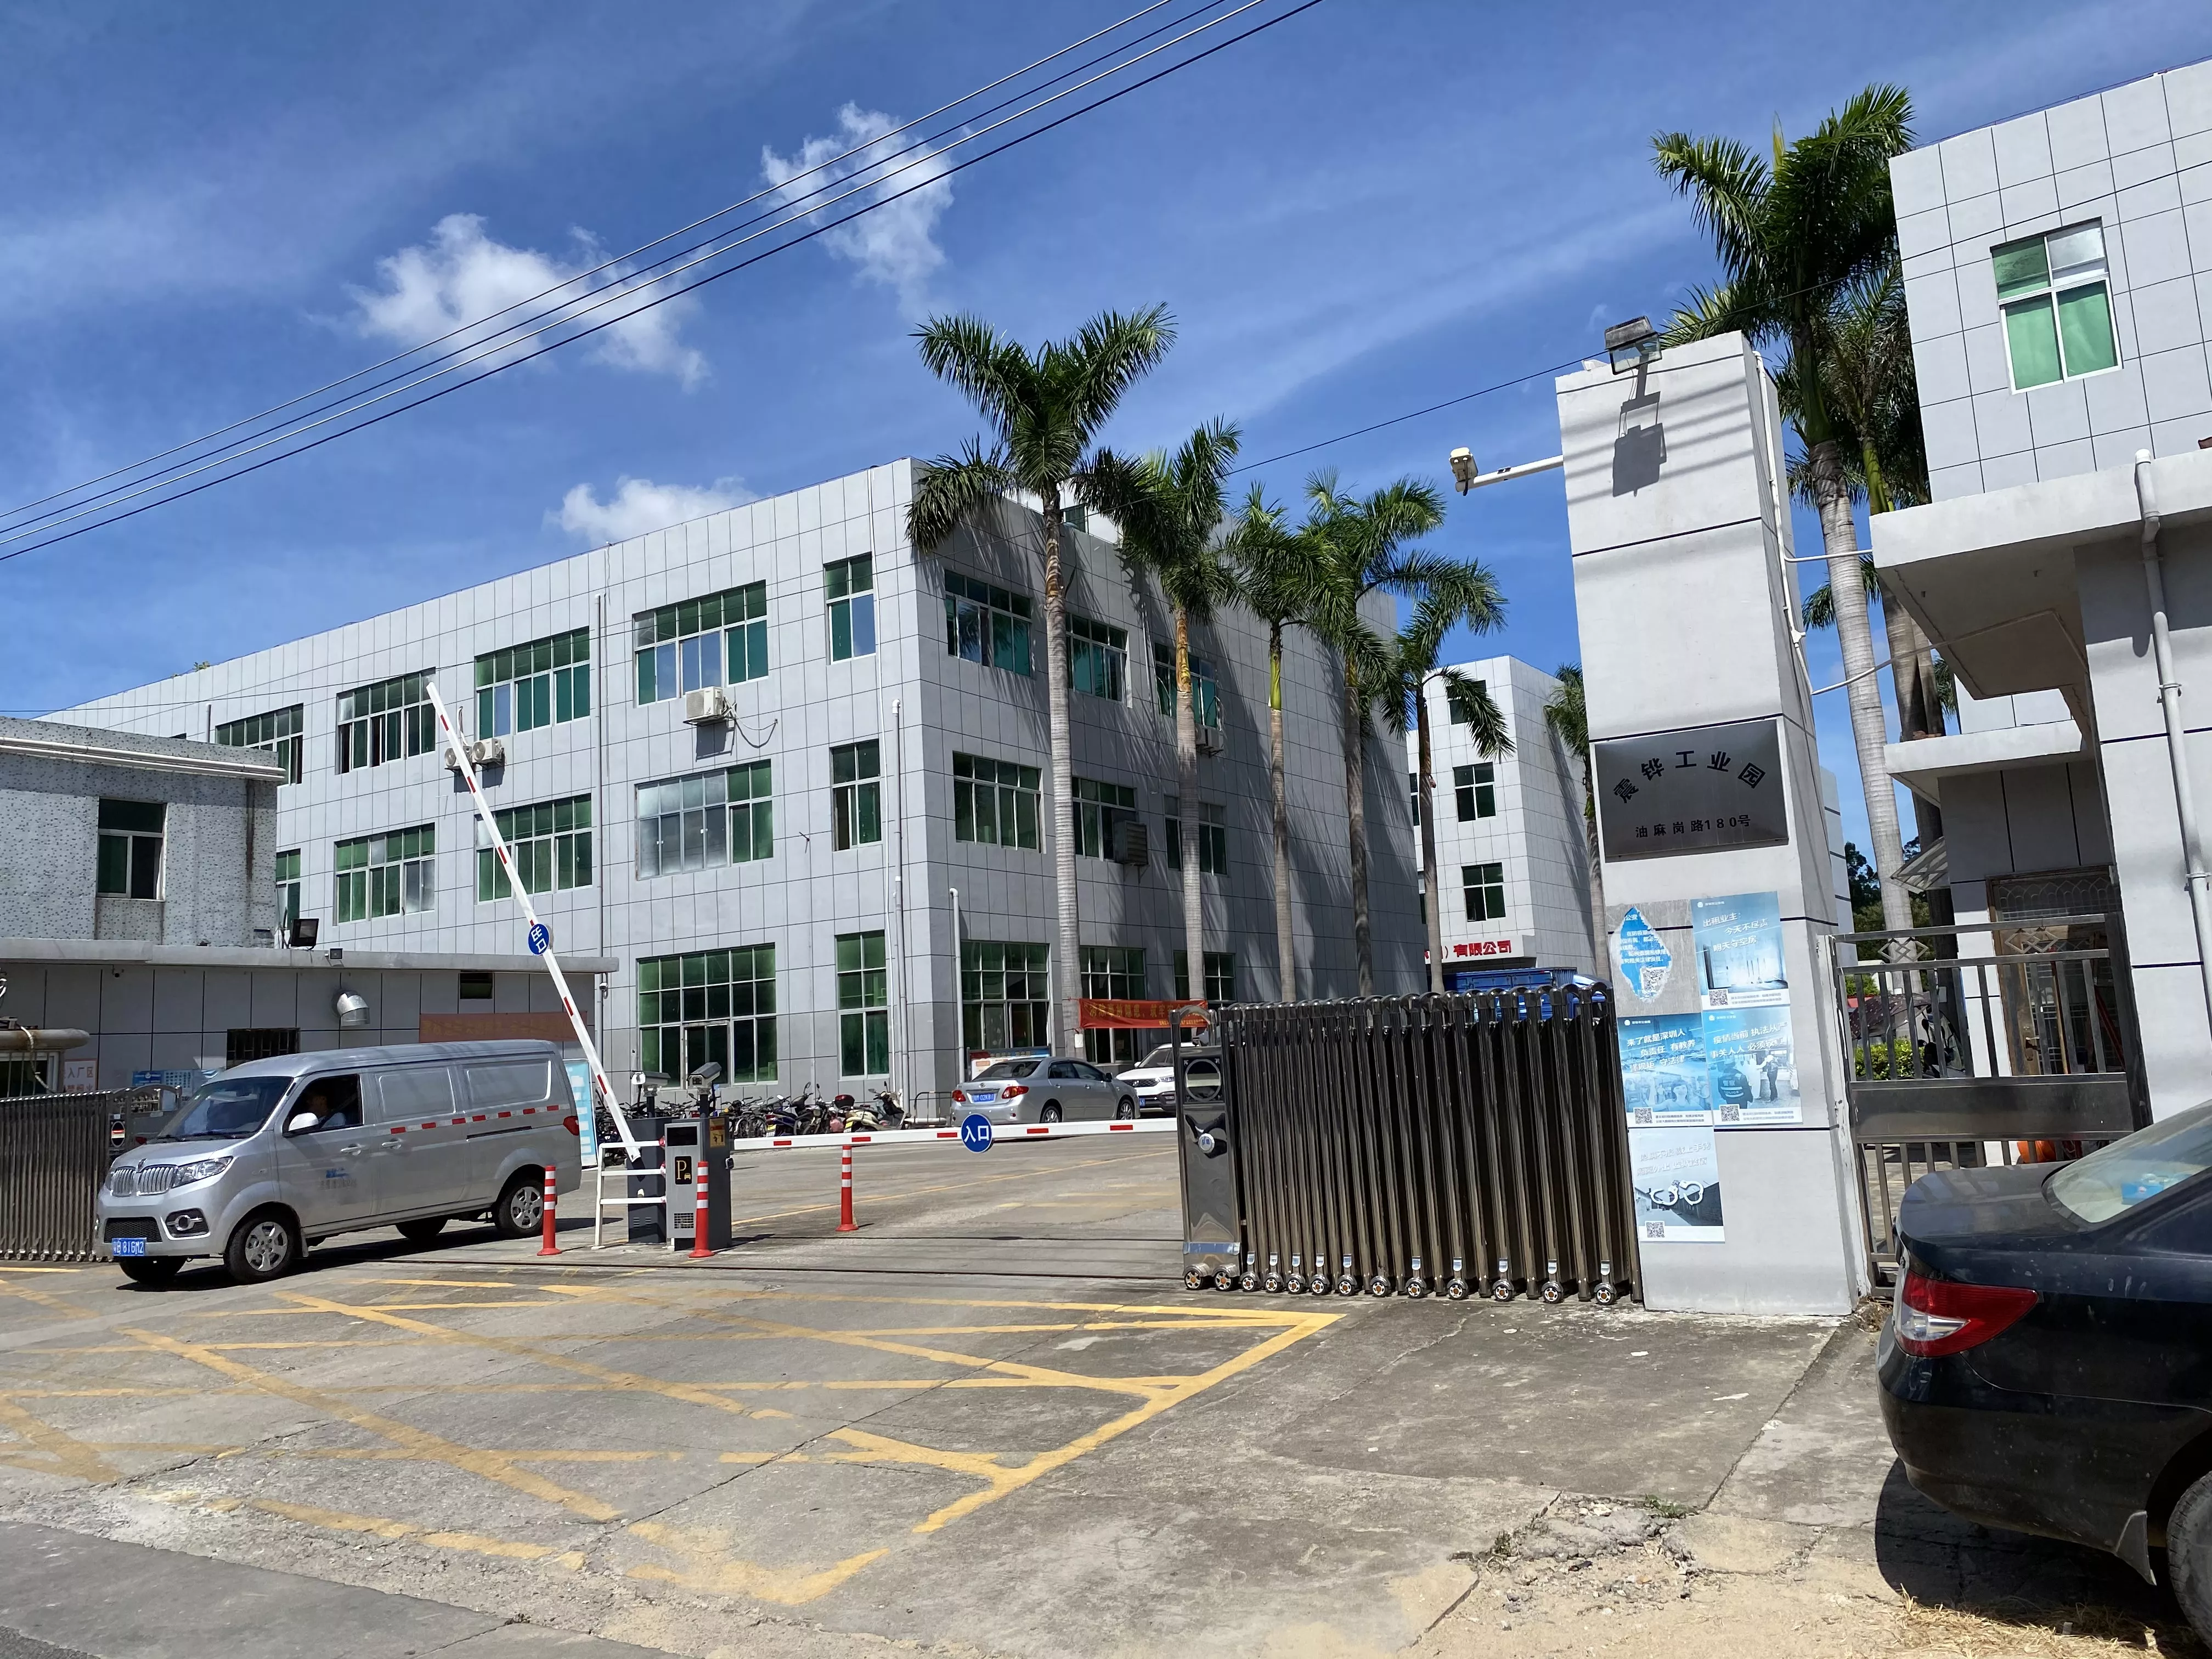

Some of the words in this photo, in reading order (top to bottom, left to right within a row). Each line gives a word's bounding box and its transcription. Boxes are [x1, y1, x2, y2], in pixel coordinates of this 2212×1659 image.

[1613, 750, 1766, 803] 震铧工业园
[1635, 814, 1751, 838] 油麻岗路180号
[531, 926, 547, 953] 出口
[1424, 939, 1512, 959] ）有限公司
[1627, 1028, 1685, 1047] 来了就是深圳人
[1713, 1030, 1749, 1045] 疫情当前
[1640, 1045, 1666, 1058] 负责任
[1670, 1039, 1696, 1051] 有教养
[64, 1067, 94, 1079] 入厂区
[964, 1125, 990, 1143] 入口
[676, 1160, 687, 1180] P
